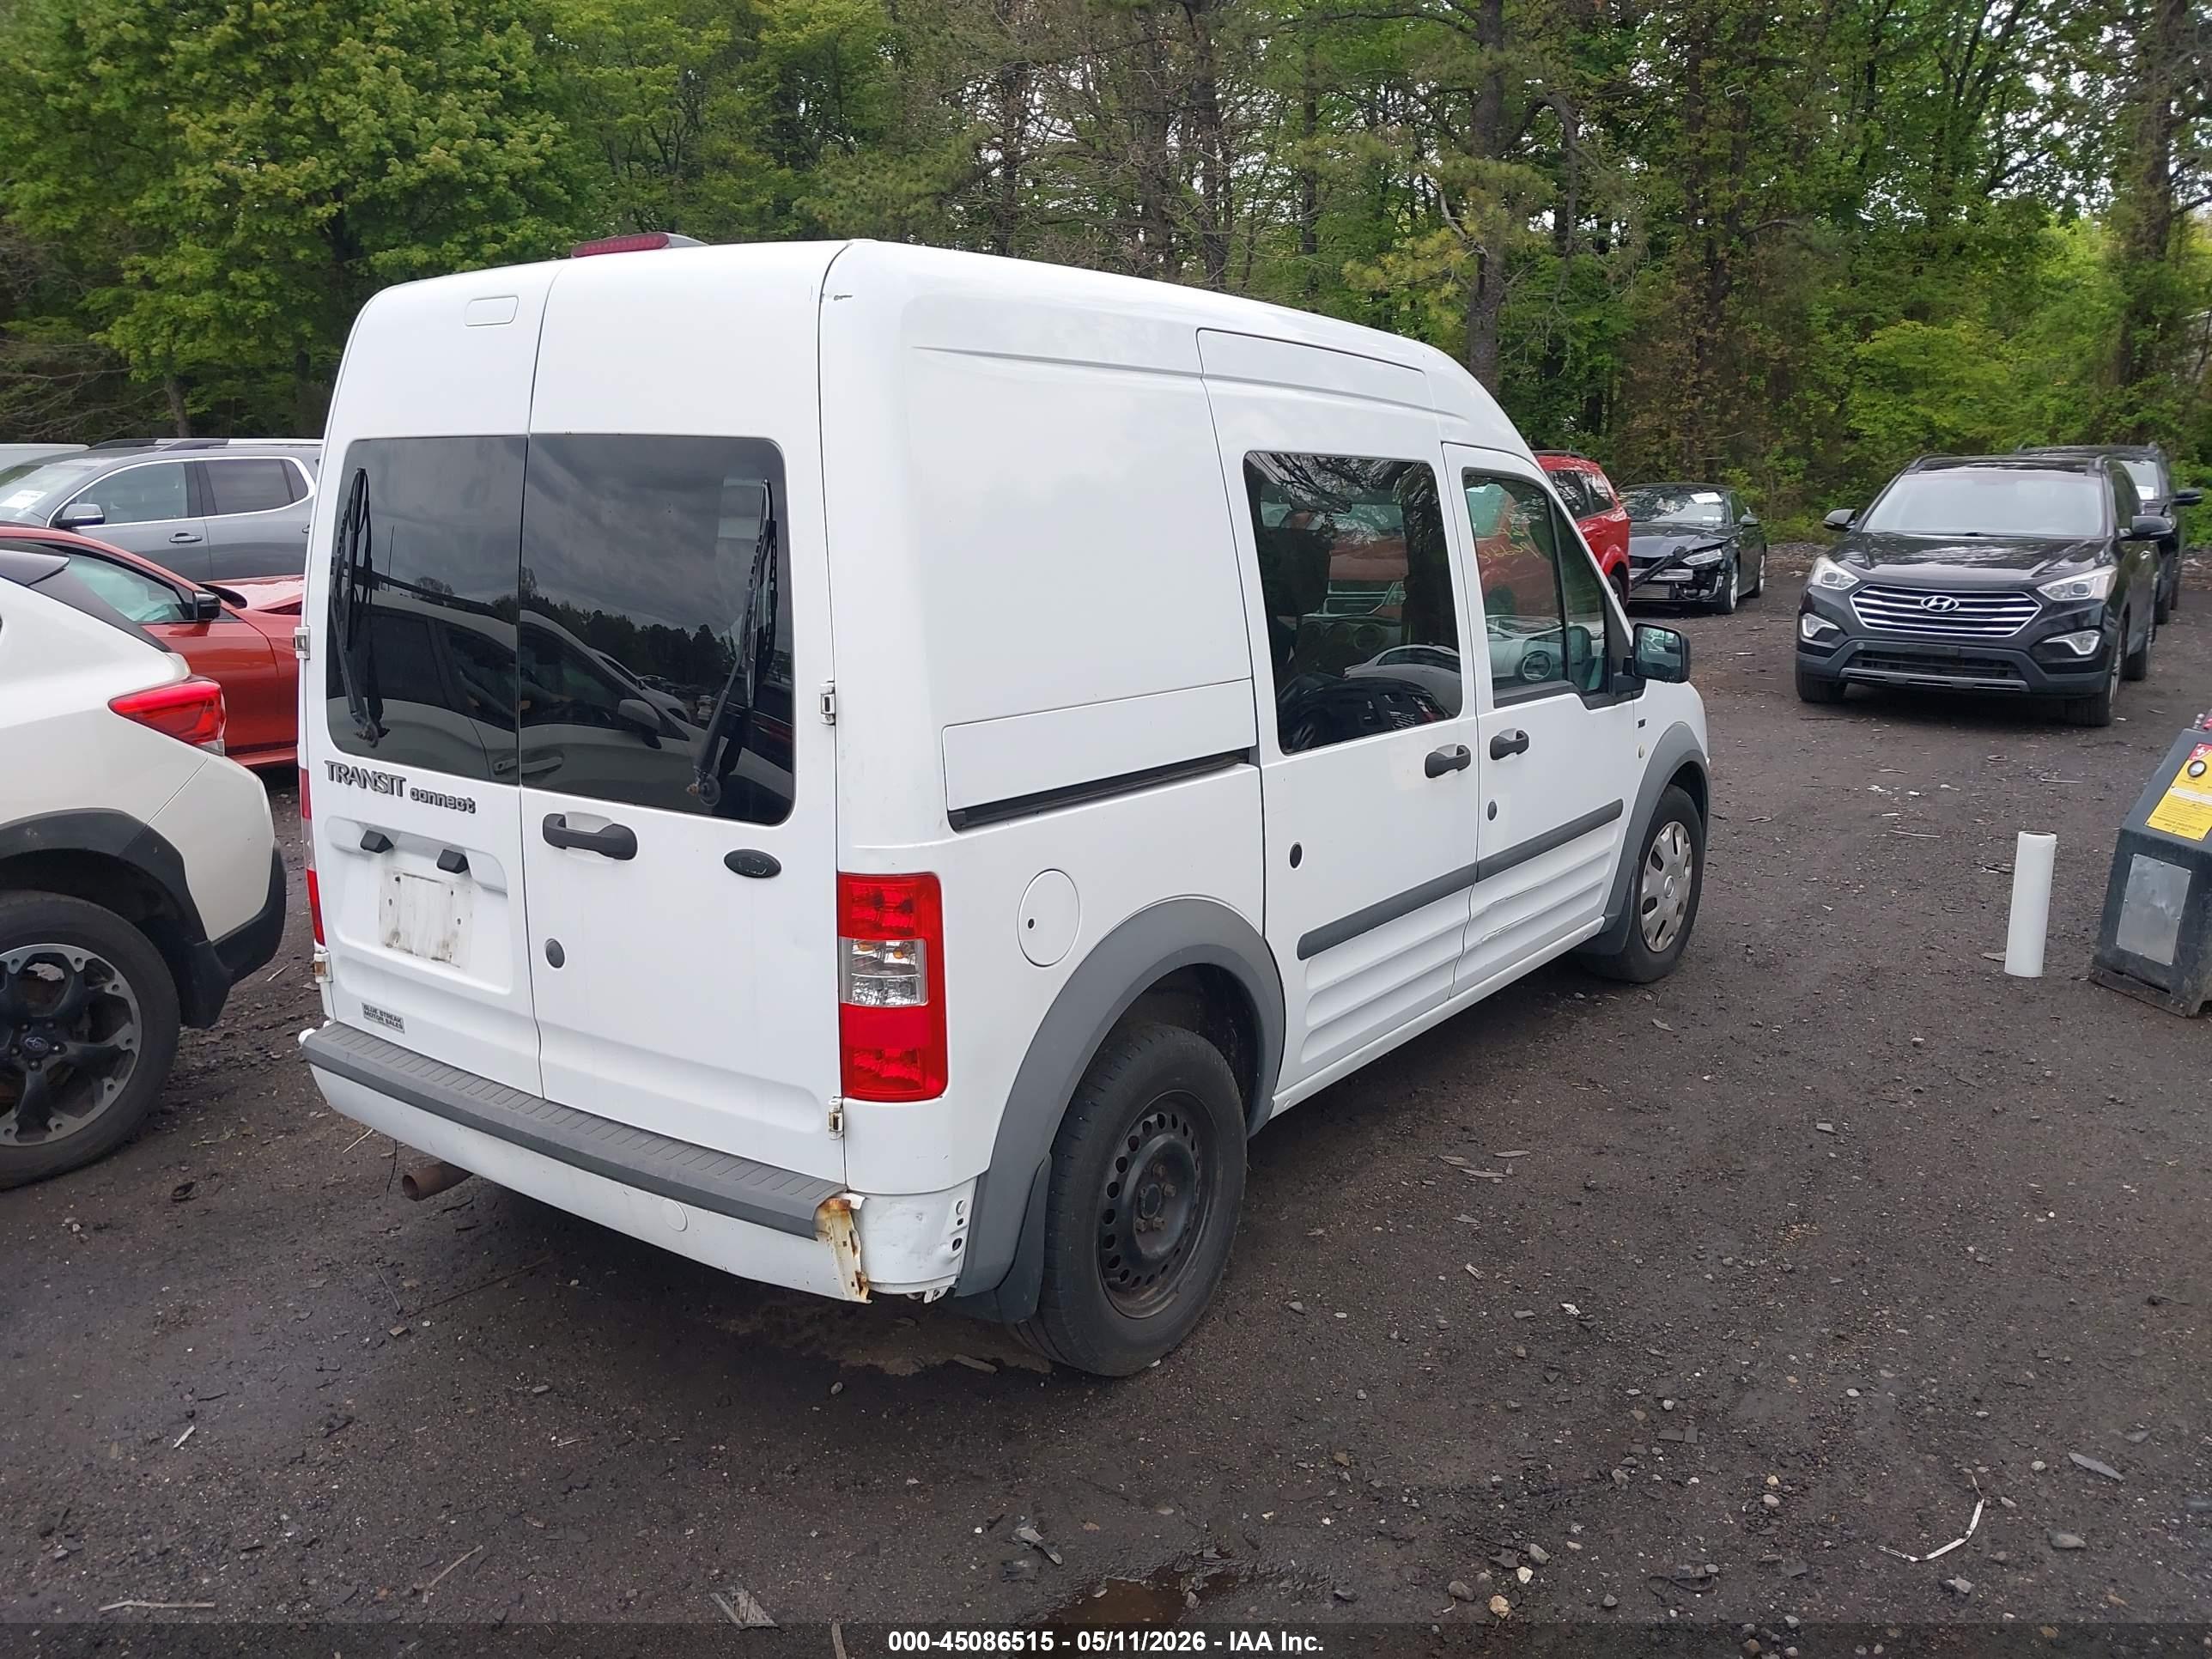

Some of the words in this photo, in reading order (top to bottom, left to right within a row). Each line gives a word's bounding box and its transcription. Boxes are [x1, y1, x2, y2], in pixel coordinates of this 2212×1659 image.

[325, 760, 406, 797] TRANSIT
[410, 787, 476, 813] connect
[363, 1011, 385, 1022] MOTOR
[385, 1018, 404, 1030] SALES
[379, 1009, 402, 1023] STREAK
